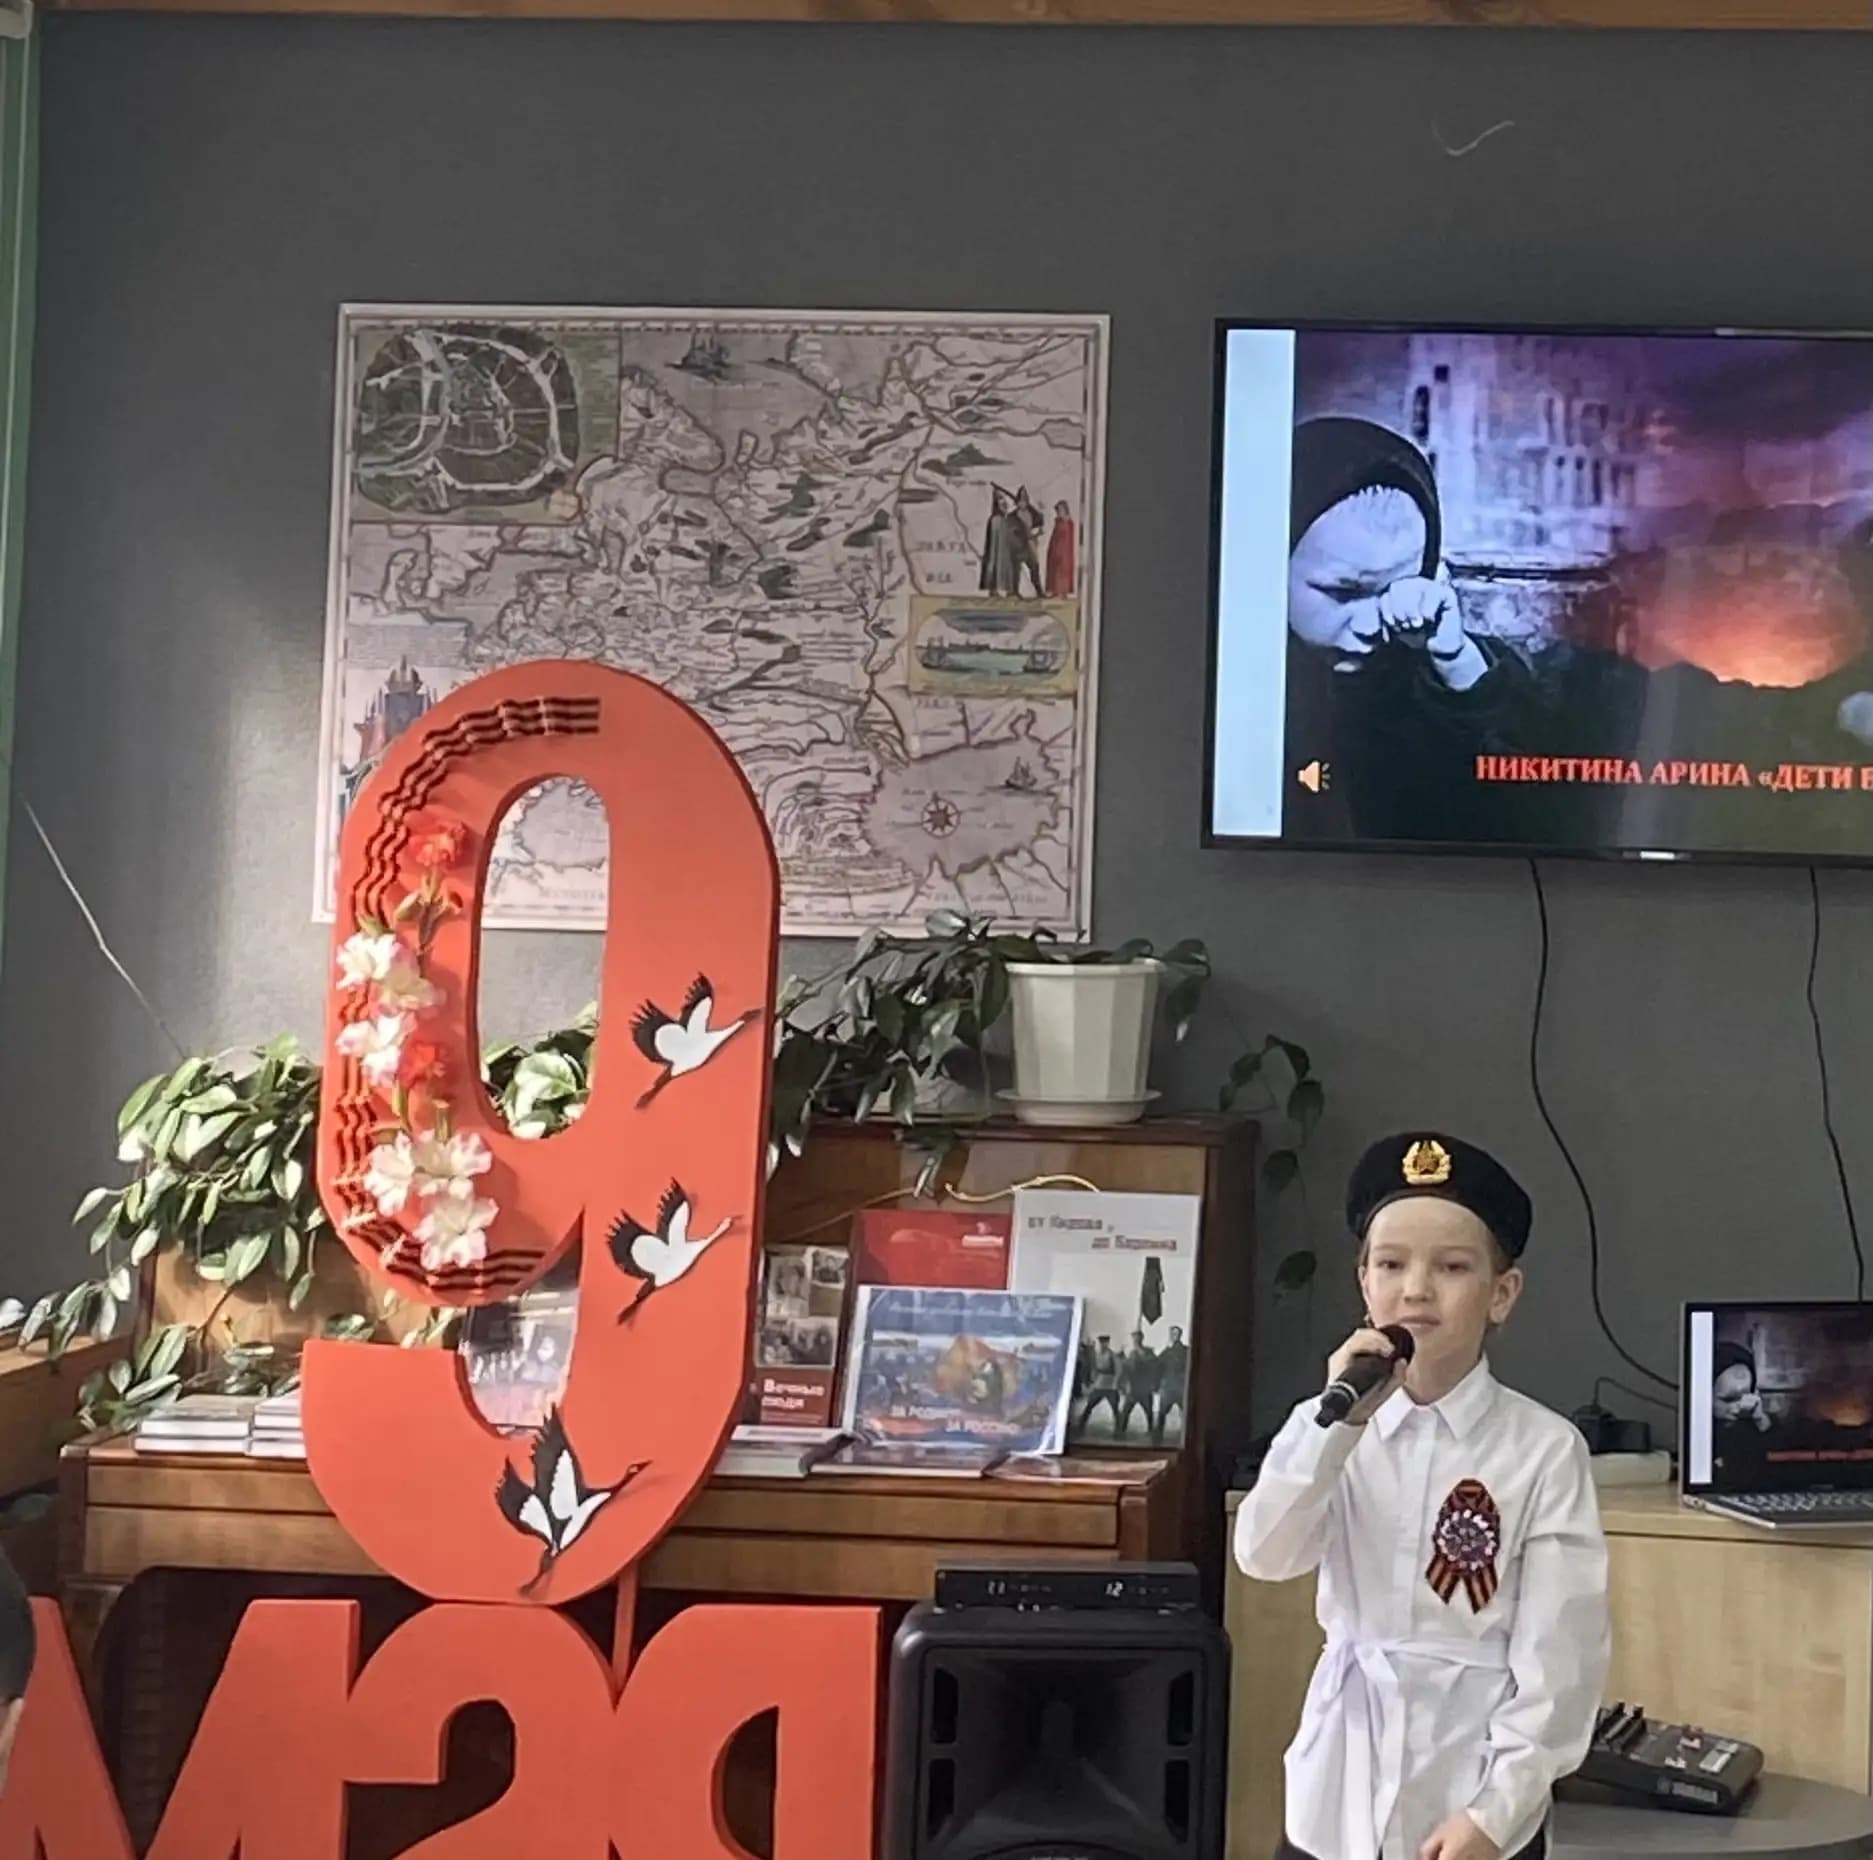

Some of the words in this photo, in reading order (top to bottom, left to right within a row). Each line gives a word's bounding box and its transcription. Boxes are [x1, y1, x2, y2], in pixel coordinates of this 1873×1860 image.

[1475, 755, 1643, 785] НИКИТИНА
[1648, 759, 1751, 787] АРИНА
[1758, 763, 1854, 793] «ДЕТИ
[302, 659, 780, 1604] 9
